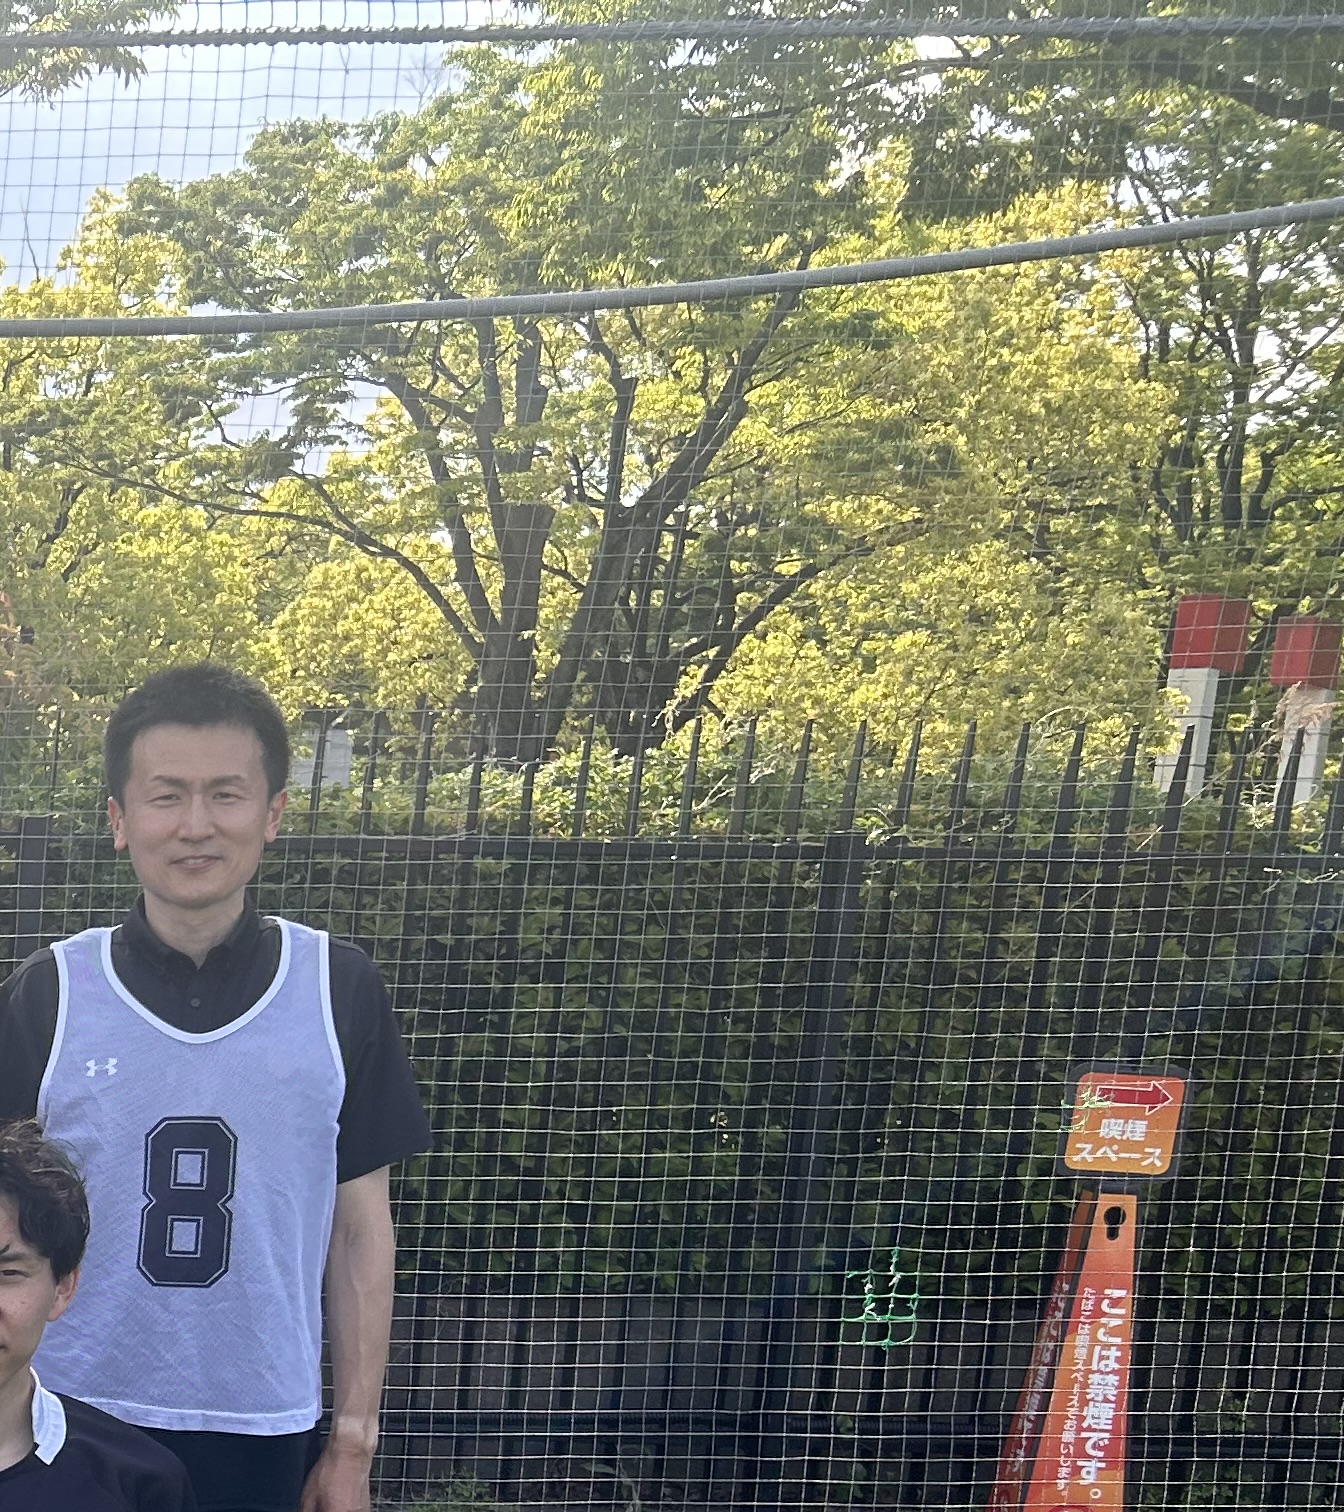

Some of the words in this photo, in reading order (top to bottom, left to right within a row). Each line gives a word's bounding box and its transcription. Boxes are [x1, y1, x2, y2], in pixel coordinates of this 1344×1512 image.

[1072, 1143, 1163, 1167] スペース
[1099, 1118, 1149, 1141] 喫煙
[136, 1116, 238, 1288] 8
[1076, 1288, 1128, 1499] ここは禁煙です。
